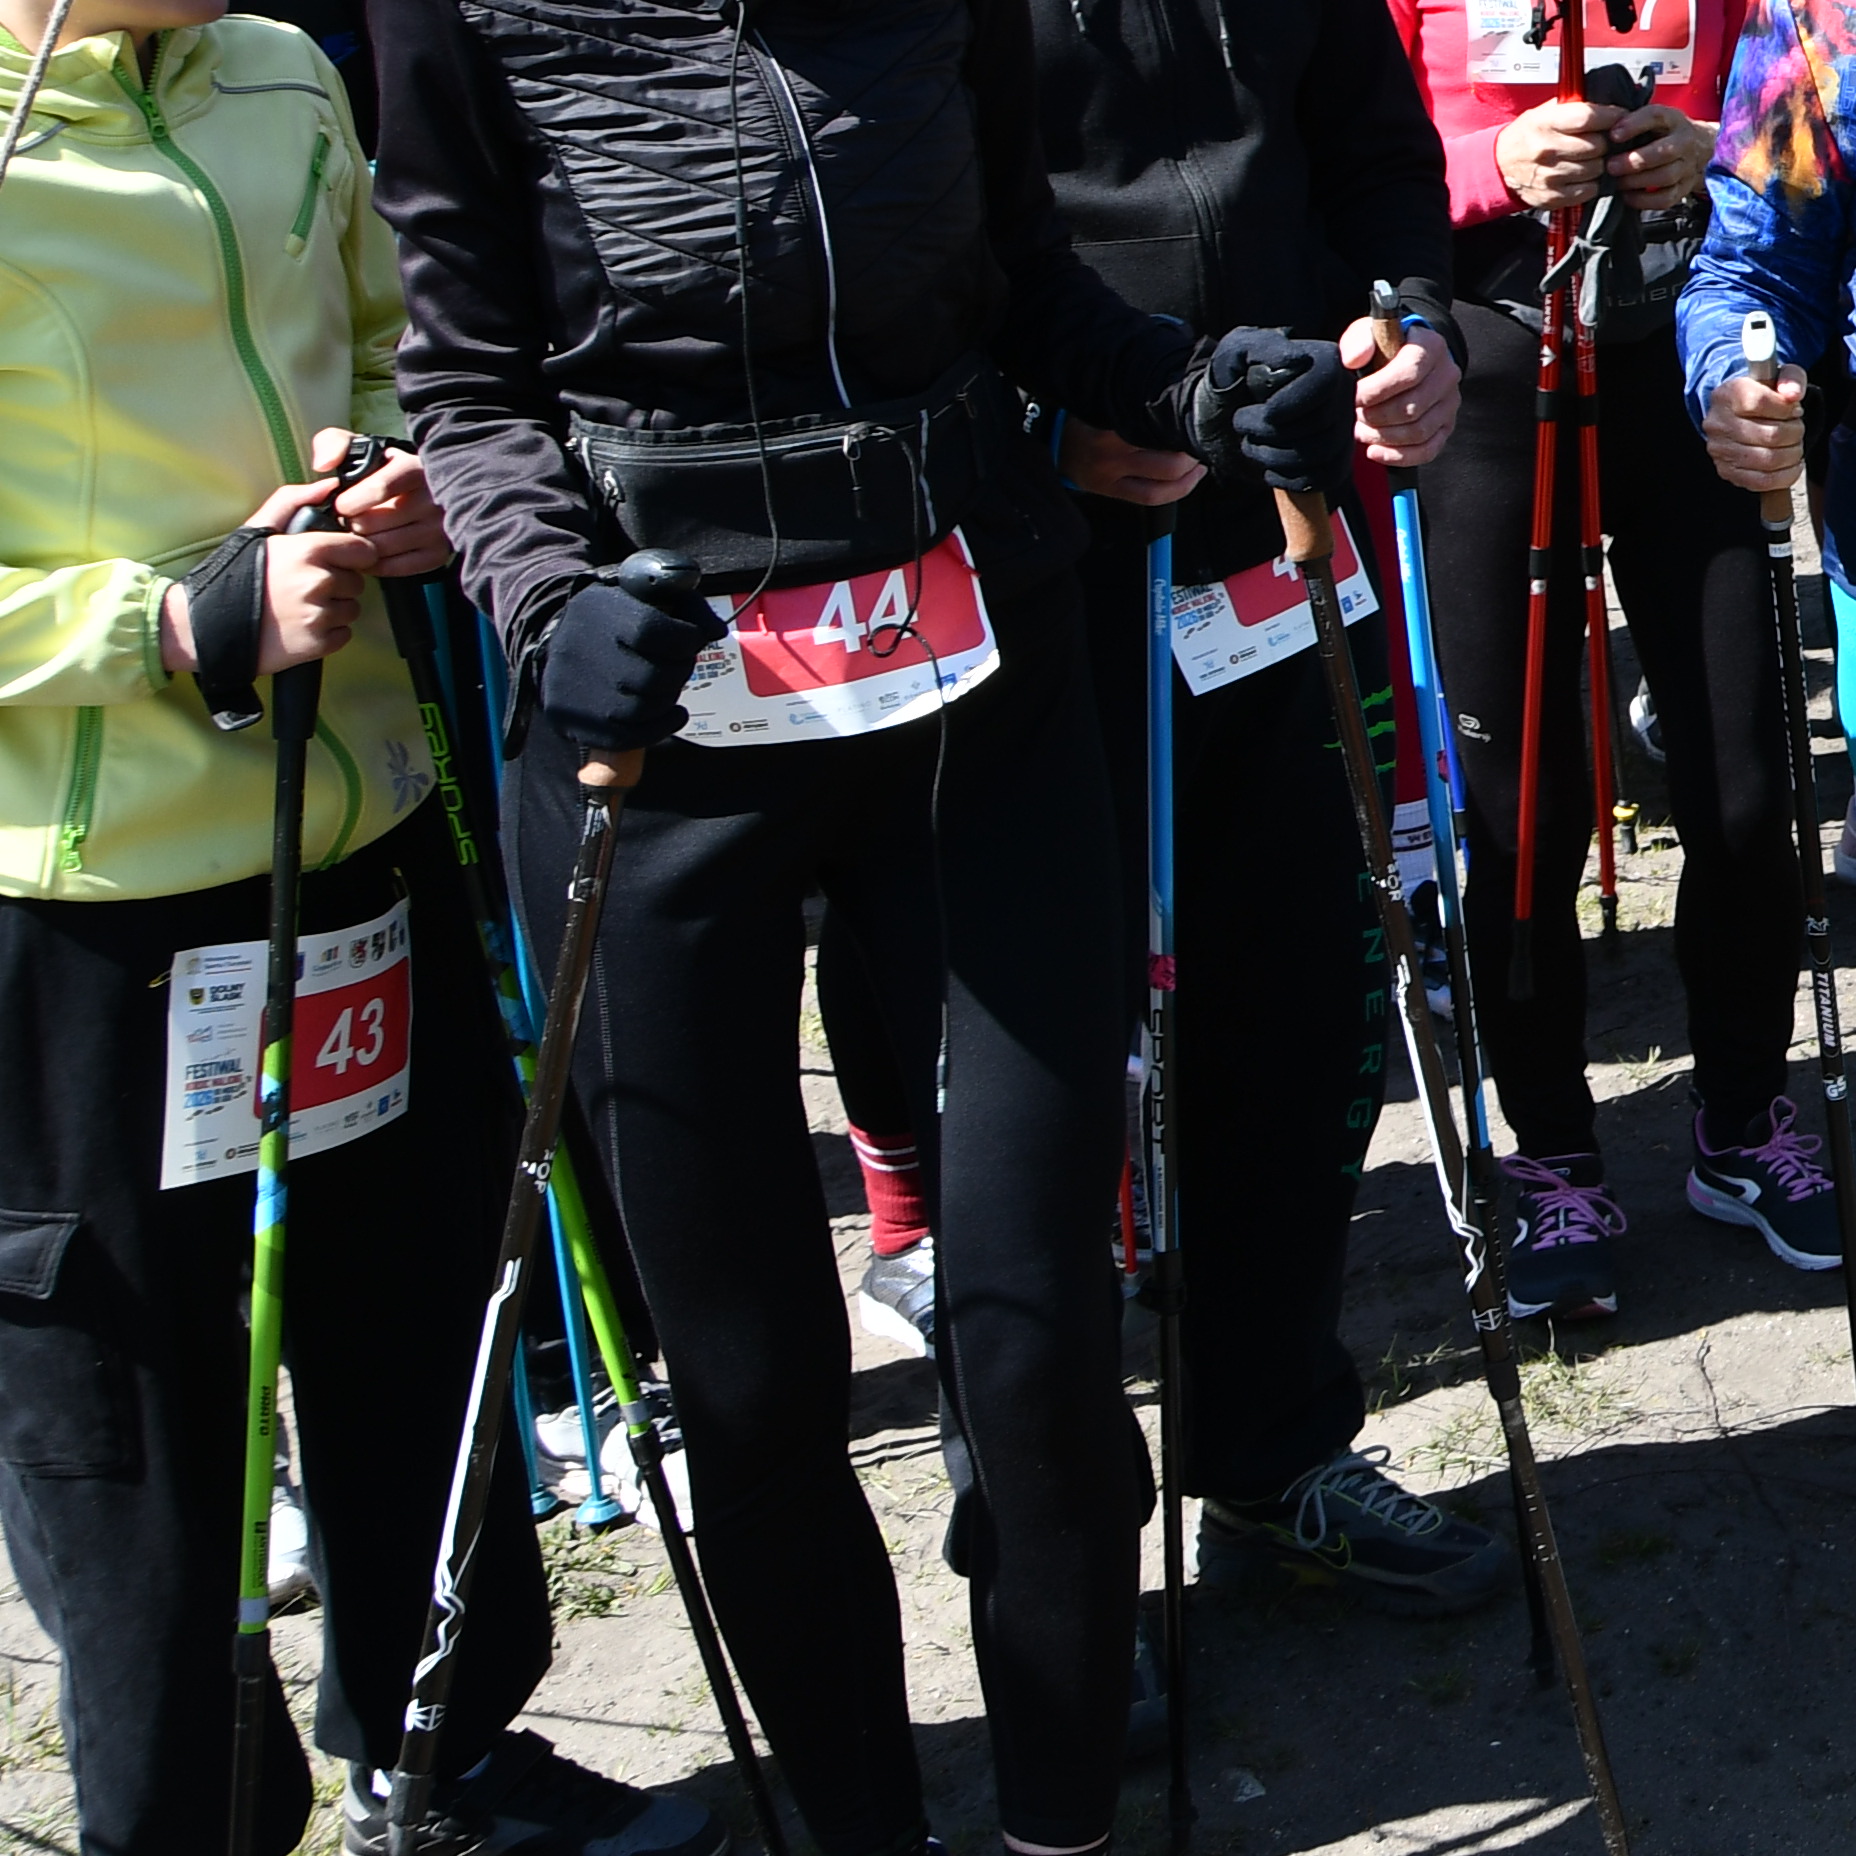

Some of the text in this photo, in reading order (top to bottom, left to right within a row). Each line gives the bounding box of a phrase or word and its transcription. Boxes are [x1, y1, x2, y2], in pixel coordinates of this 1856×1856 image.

[1171, 583, 1219, 606] ESTIWAL
[1272, 553, 1300, 583] 4
[813, 568, 919, 653] 44
[209, 982, 245, 995] DOLNY
[1816, 971, 1837, 1049] TITANIUM
[315, 997, 385, 1075] 43
[1342, 870, 1386, 1181] ENERGY
[185, 1057, 244, 1081] FESTIWAL
